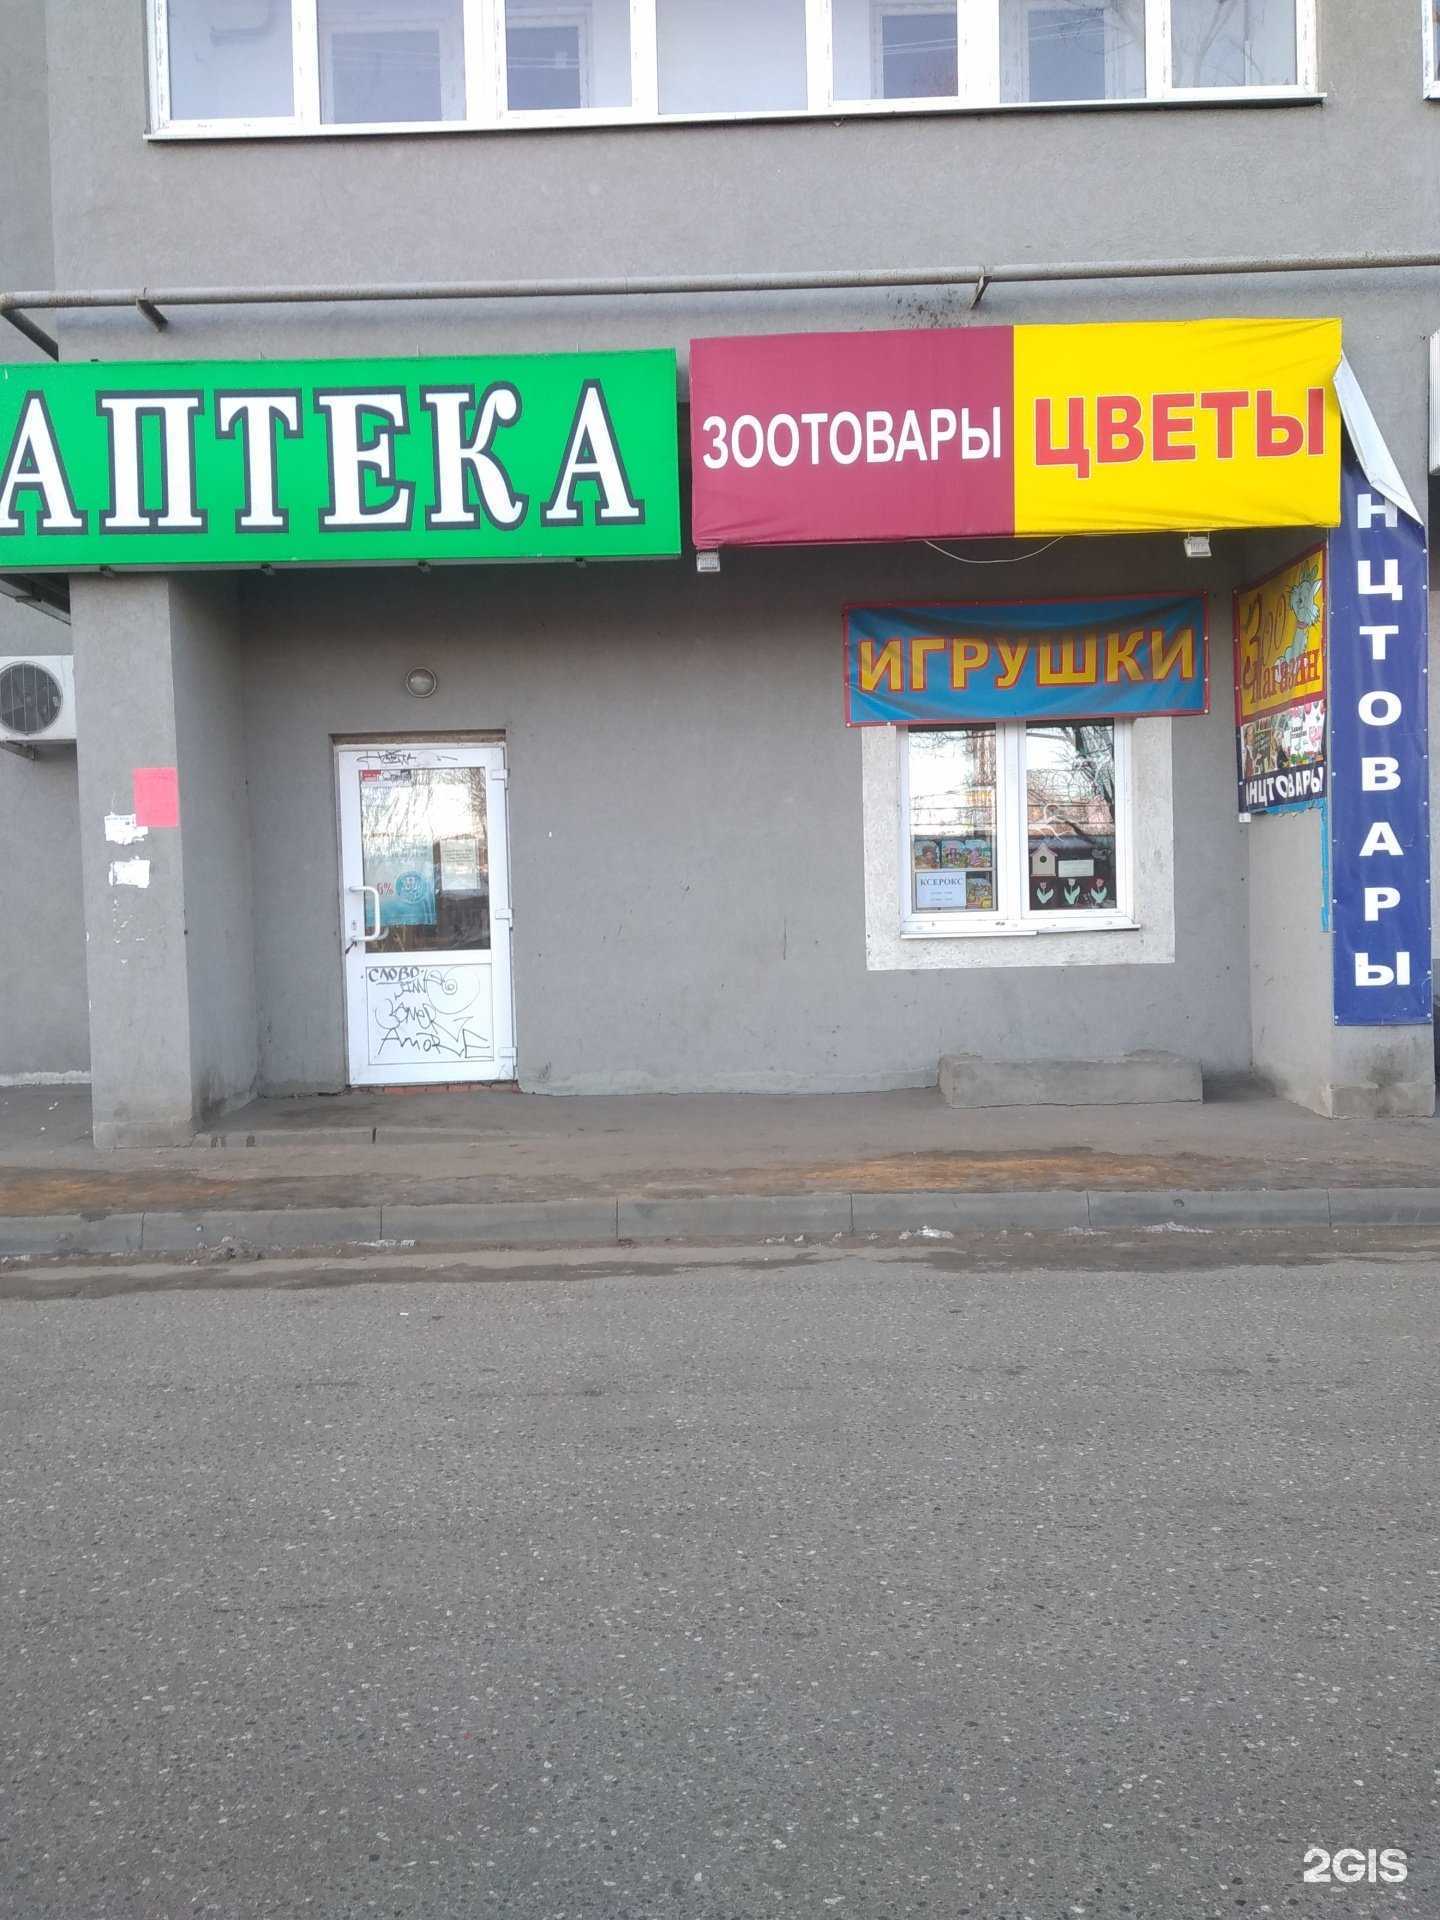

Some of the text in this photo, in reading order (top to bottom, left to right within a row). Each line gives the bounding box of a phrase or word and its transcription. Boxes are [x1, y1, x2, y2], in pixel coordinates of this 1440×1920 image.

[0, 379, 645, 535] АПТЕКА
[702, 406, 1002, 470] ЗООТОВАРЫ
[1034, 387, 1325, 480] ЦВЕТЫ
[857, 627, 1195, 693] ИГРУШКИ
[920, 877, 963, 887] КСЕРОКС
